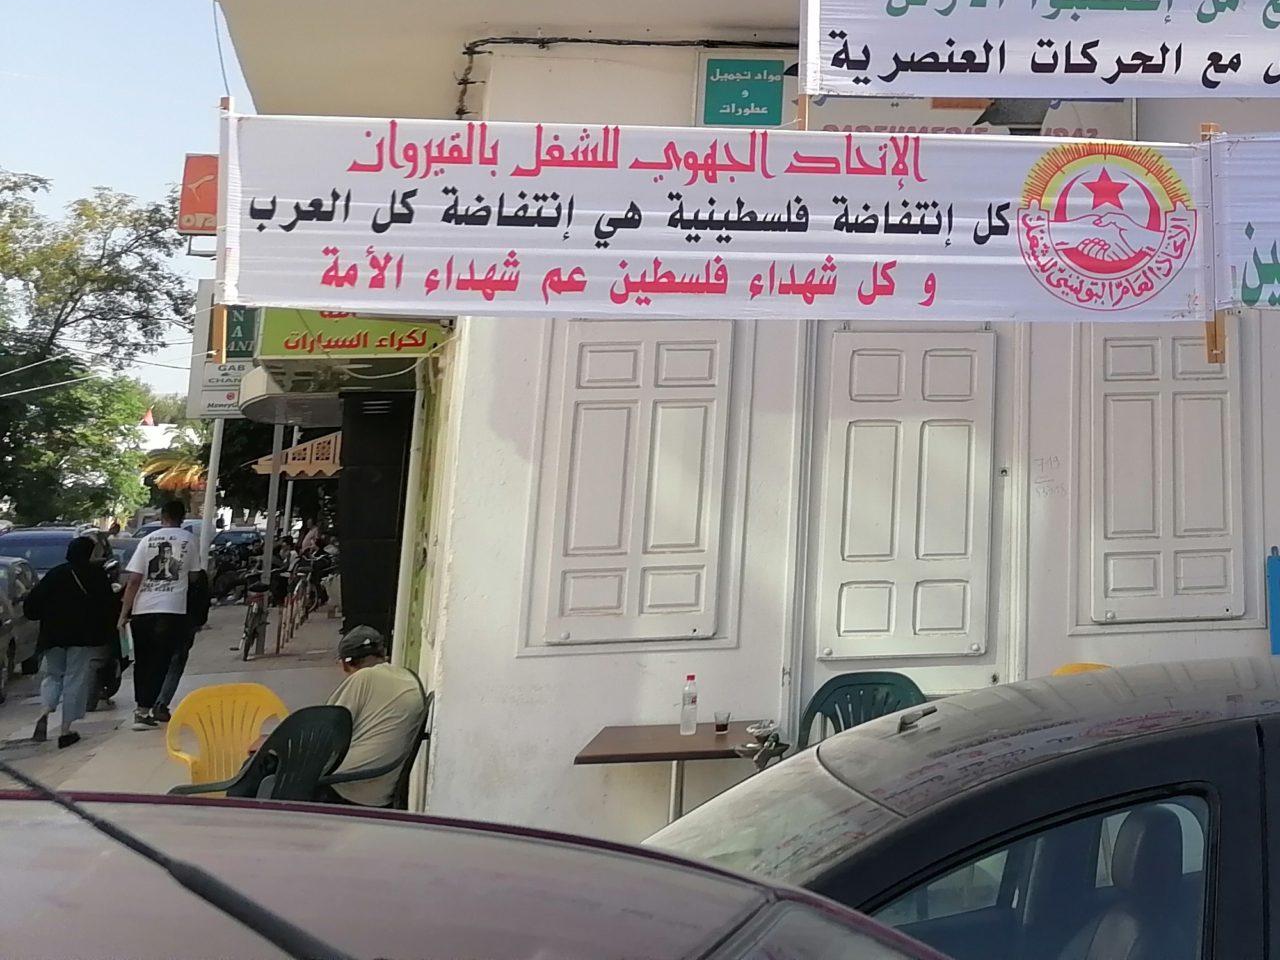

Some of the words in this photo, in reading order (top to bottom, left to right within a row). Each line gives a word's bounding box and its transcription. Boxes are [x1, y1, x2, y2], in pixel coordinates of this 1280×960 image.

[710, 68, 752, 82] تجميل
[754, 71, 782, 83] مواد
[823, 27, 1005, 90] العنصرية
[1031, 38, 1182, 84] الحركات
[1205, 52, 1241, 87] مع
[719, 102, 769, 116] عطورات
[347, 118, 499, 179] بالقيروان
[510, 124, 620, 177] للشغل
[629, 132, 776, 186] الجهوي
[784, 132, 929, 190] الإتحاد
[248, 188, 351, 232] العرب
[371, 188, 418, 233] كل
[440, 186, 574, 241] إنتفاضة
[594, 201, 642, 249] هي
[665, 192, 809, 246] فلسطينية
[829, 196, 959, 248] إنتفاضة
[969, 202, 1010, 245] كل
[320, 245, 404, 289] الأمة
[424, 250, 520, 301] شهداء
[610, 255, 728, 305] فلسطين
[749, 252, 839, 305] شهداء
[858, 260, 897, 305] كل
[918, 273, 936, 306] و
[283, 329, 369, 354] السيارات
[375, 327, 428, 352] لكراء
[218, 364, 246, 372] GAB
